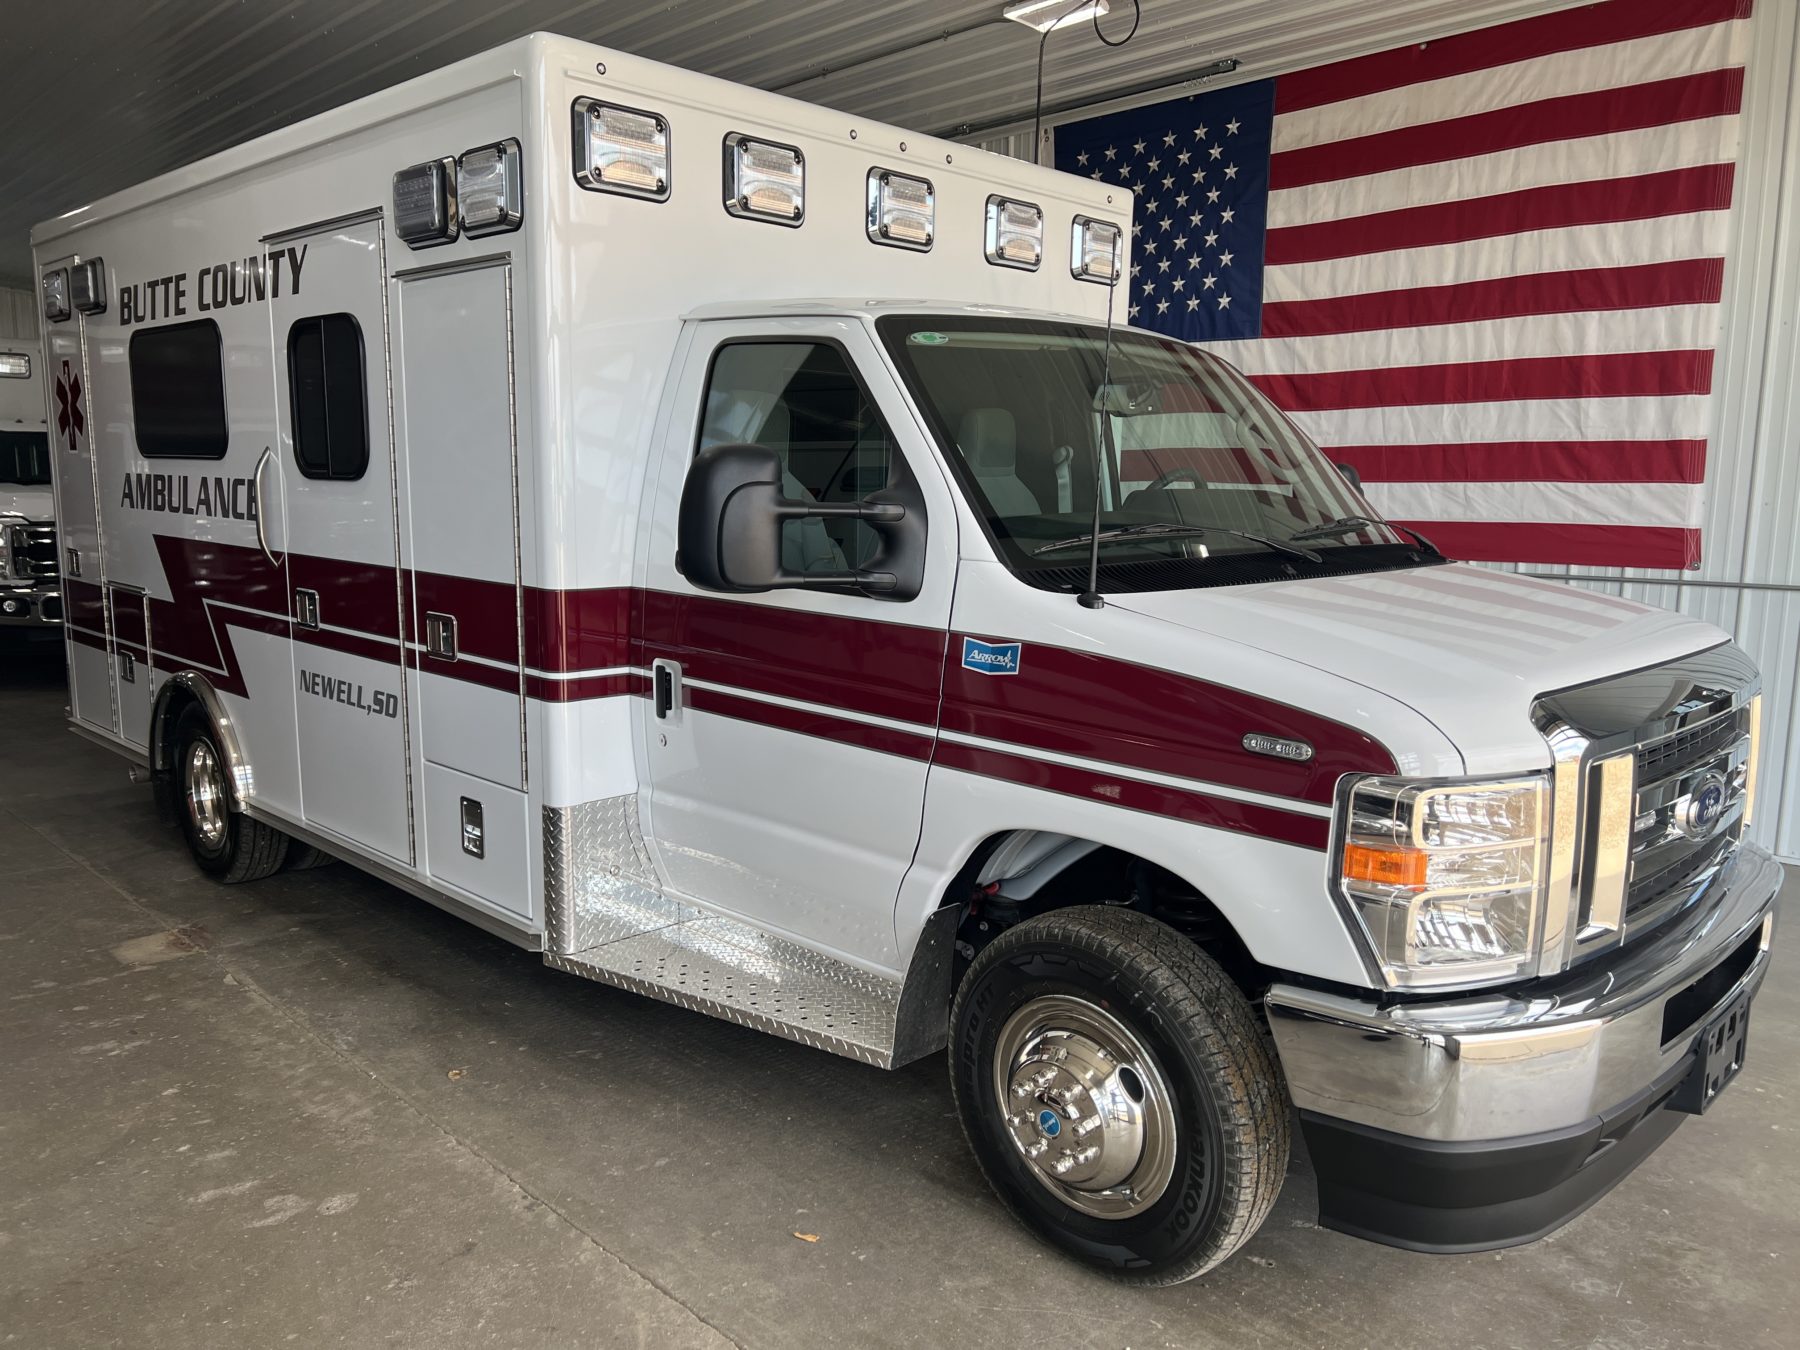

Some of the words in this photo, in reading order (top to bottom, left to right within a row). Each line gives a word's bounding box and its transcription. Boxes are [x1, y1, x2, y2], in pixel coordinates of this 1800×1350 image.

[120, 273, 186, 326] BUTTE
[198, 244, 308, 312] COUNTY
[300, 669, 399, 719] NEWELL,SD
